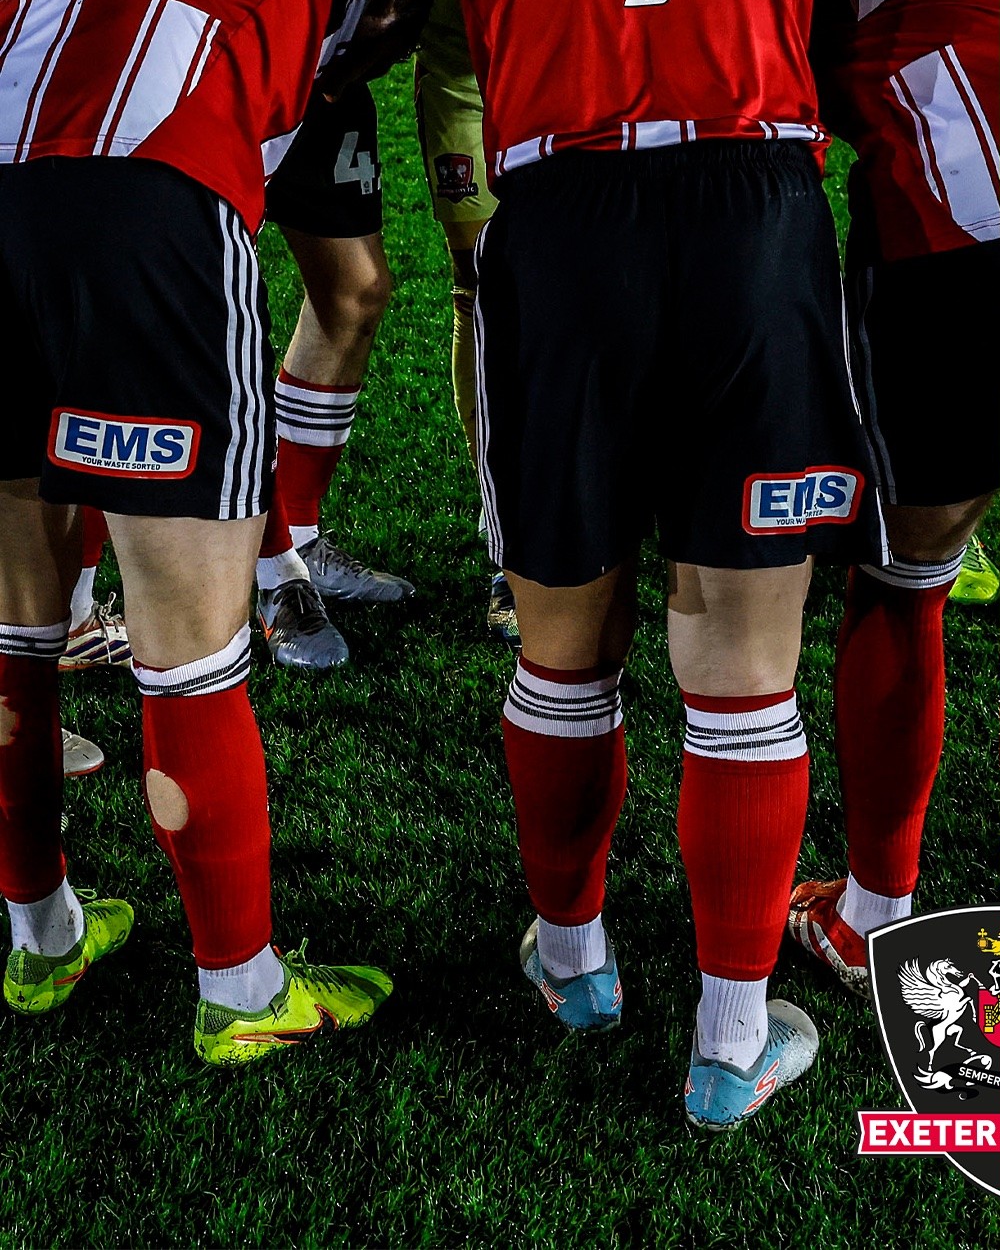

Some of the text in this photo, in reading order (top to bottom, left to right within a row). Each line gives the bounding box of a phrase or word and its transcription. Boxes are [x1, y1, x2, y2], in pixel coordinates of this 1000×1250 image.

[64, 416, 185, 464] EMS
[82, 456, 161, 471] YOUR WASTE SORTED
